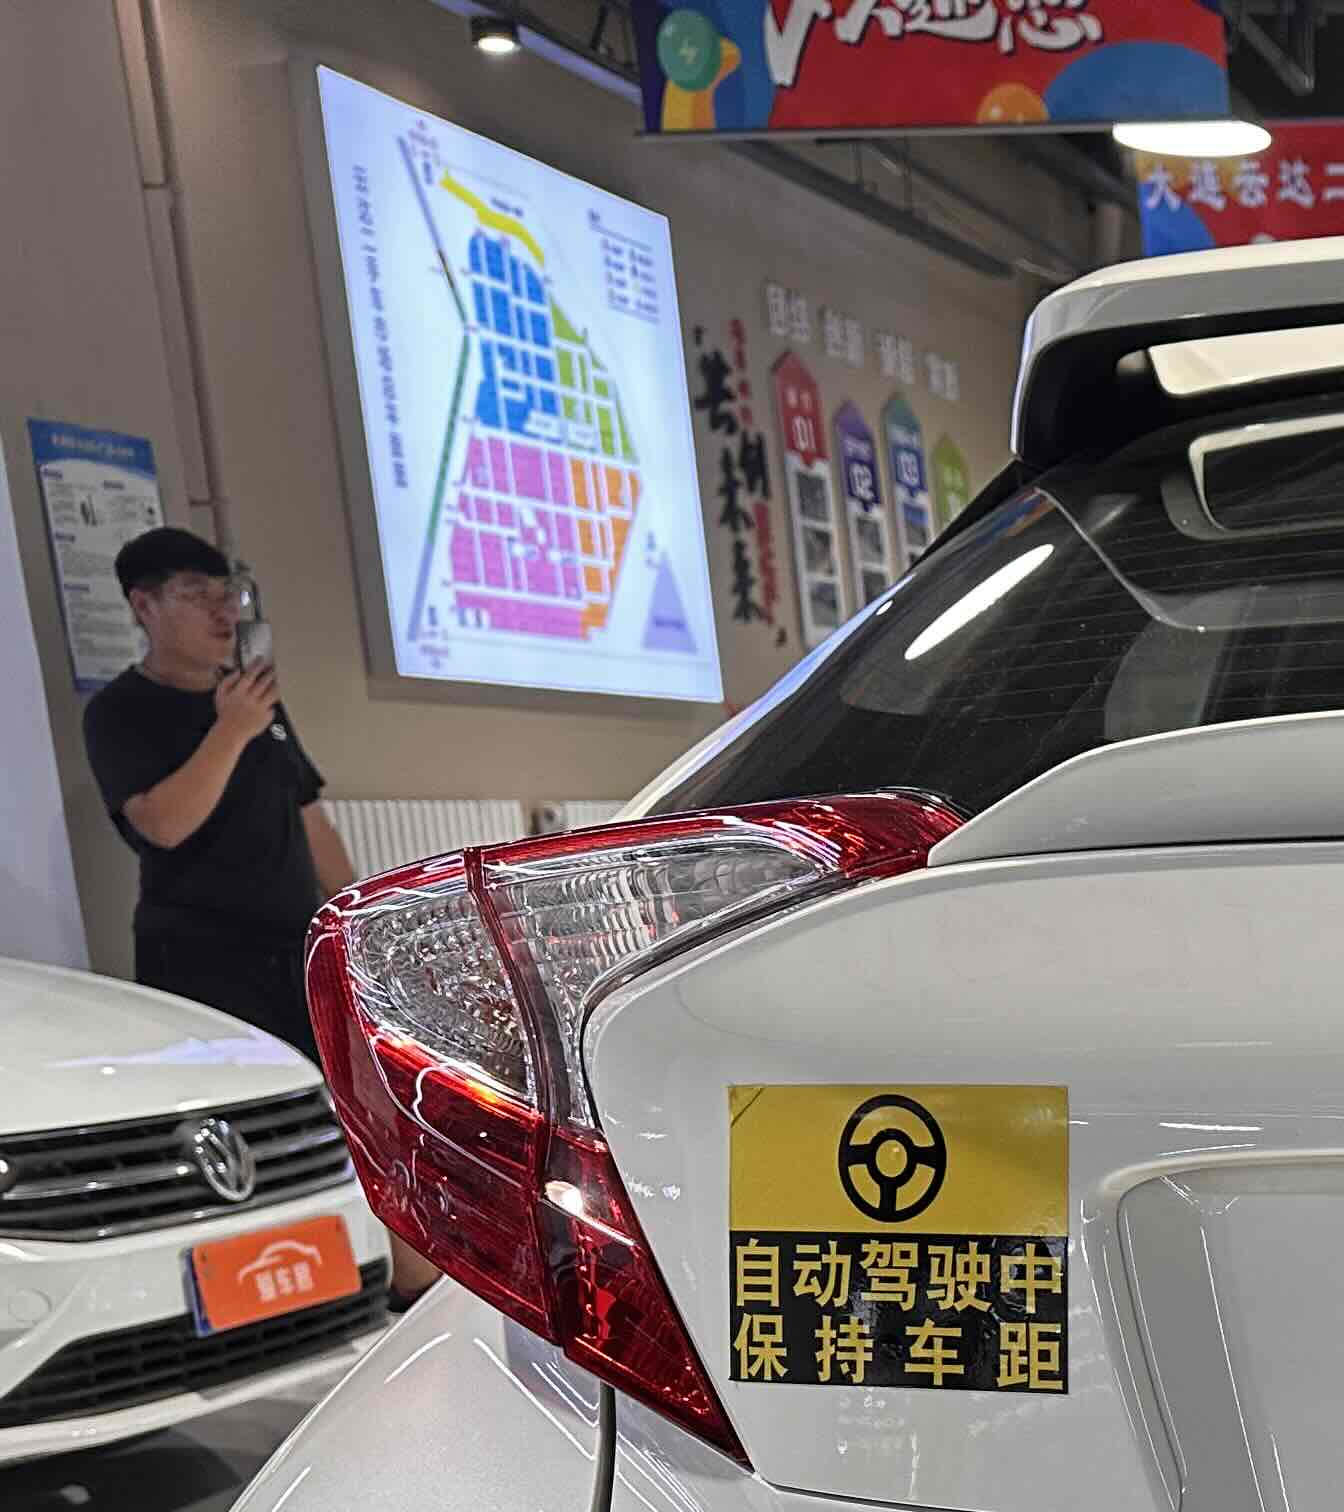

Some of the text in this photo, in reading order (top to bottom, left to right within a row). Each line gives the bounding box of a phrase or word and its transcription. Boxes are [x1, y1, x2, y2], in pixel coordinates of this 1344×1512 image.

[735, 1238, 1063, 1314] 自动驾驶中
[733, 1313, 1064, 1391] 保持车距
